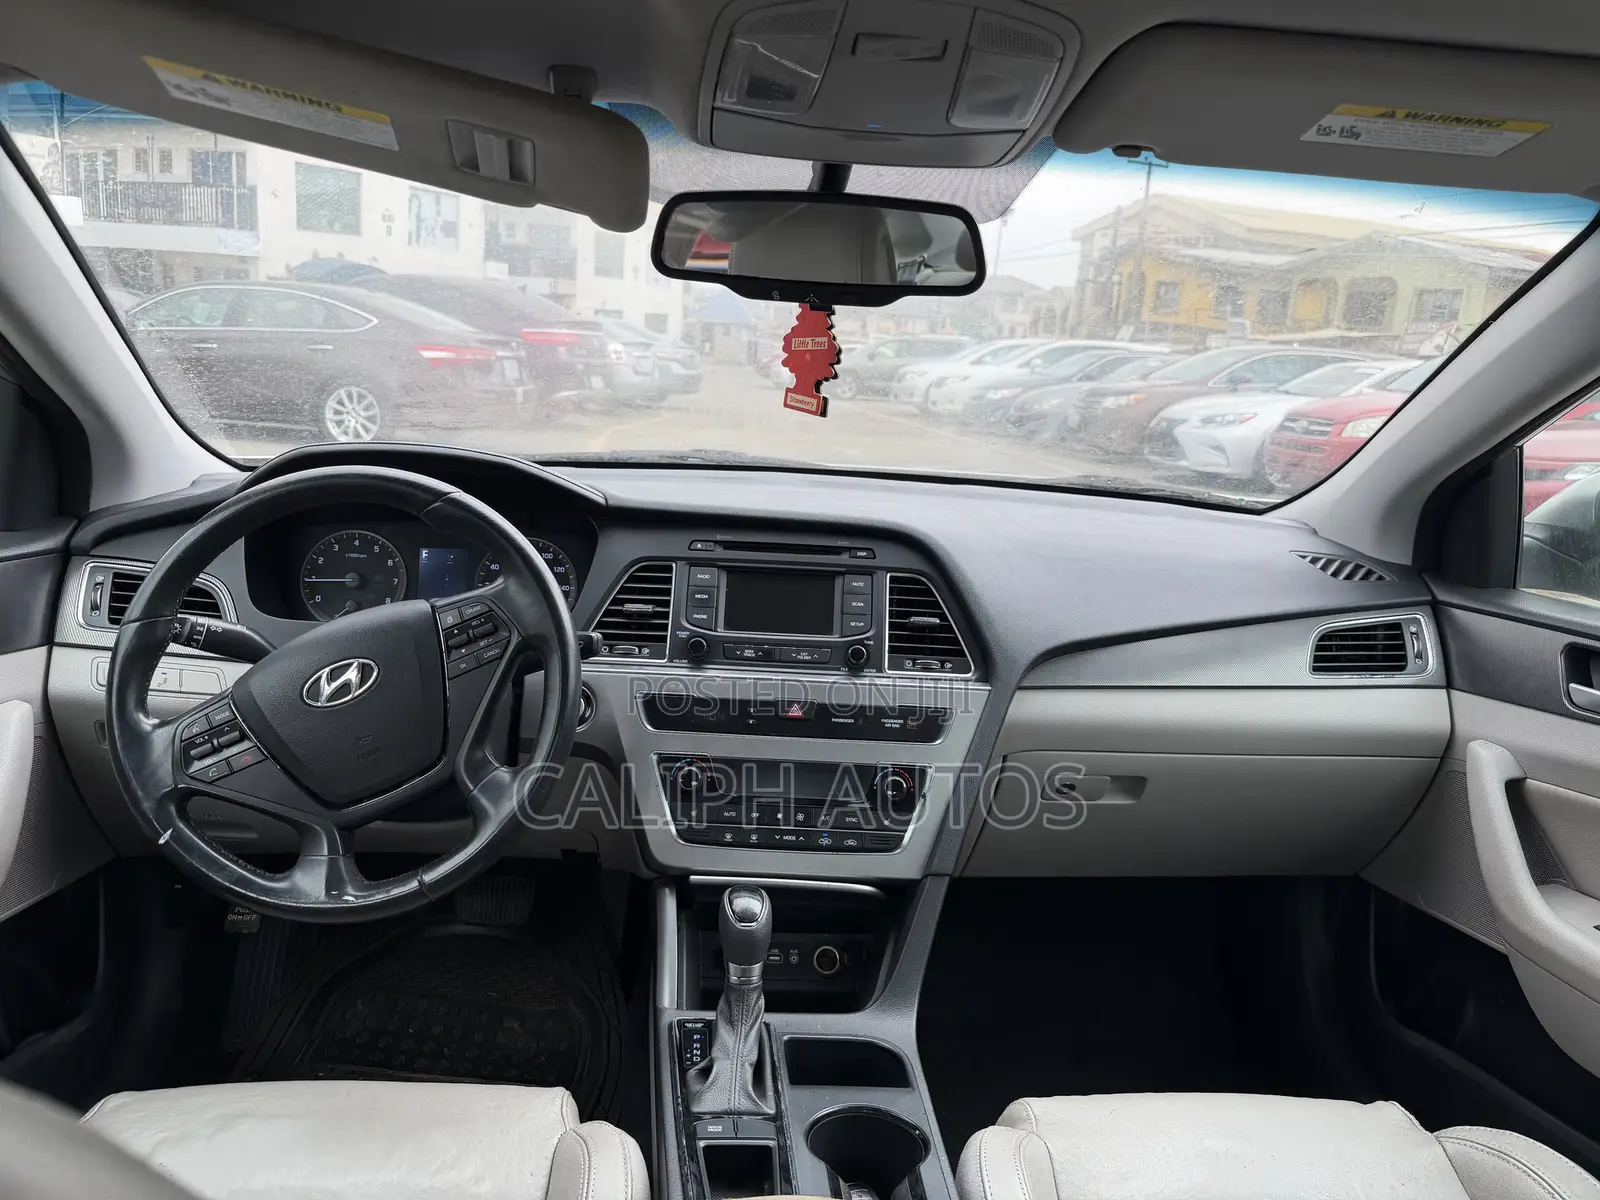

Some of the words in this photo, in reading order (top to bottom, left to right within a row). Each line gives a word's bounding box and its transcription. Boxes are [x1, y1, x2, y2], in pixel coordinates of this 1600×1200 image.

[227, 77, 342, 113] WARNING
[1403, 111, 1507, 127] WARNING
[793, 338, 810, 349] Little
[811, 338, 826, 349] Trees
[789, 395, 815, 408] Strawberry
[333, 544, 339, 552] 3
[374, 545, 380, 553] 5
[422, 550, 429, 559] F
[318, 556, 324, 564] 2
[387, 559, 393, 567] 6
[490, 563, 499, 571] 40
[393, 578, 399, 586] 7
[315, 595, 321, 603] 0
[483, 648, 501, 658] CANCEL
[214, 711, 230, 721] MODE
